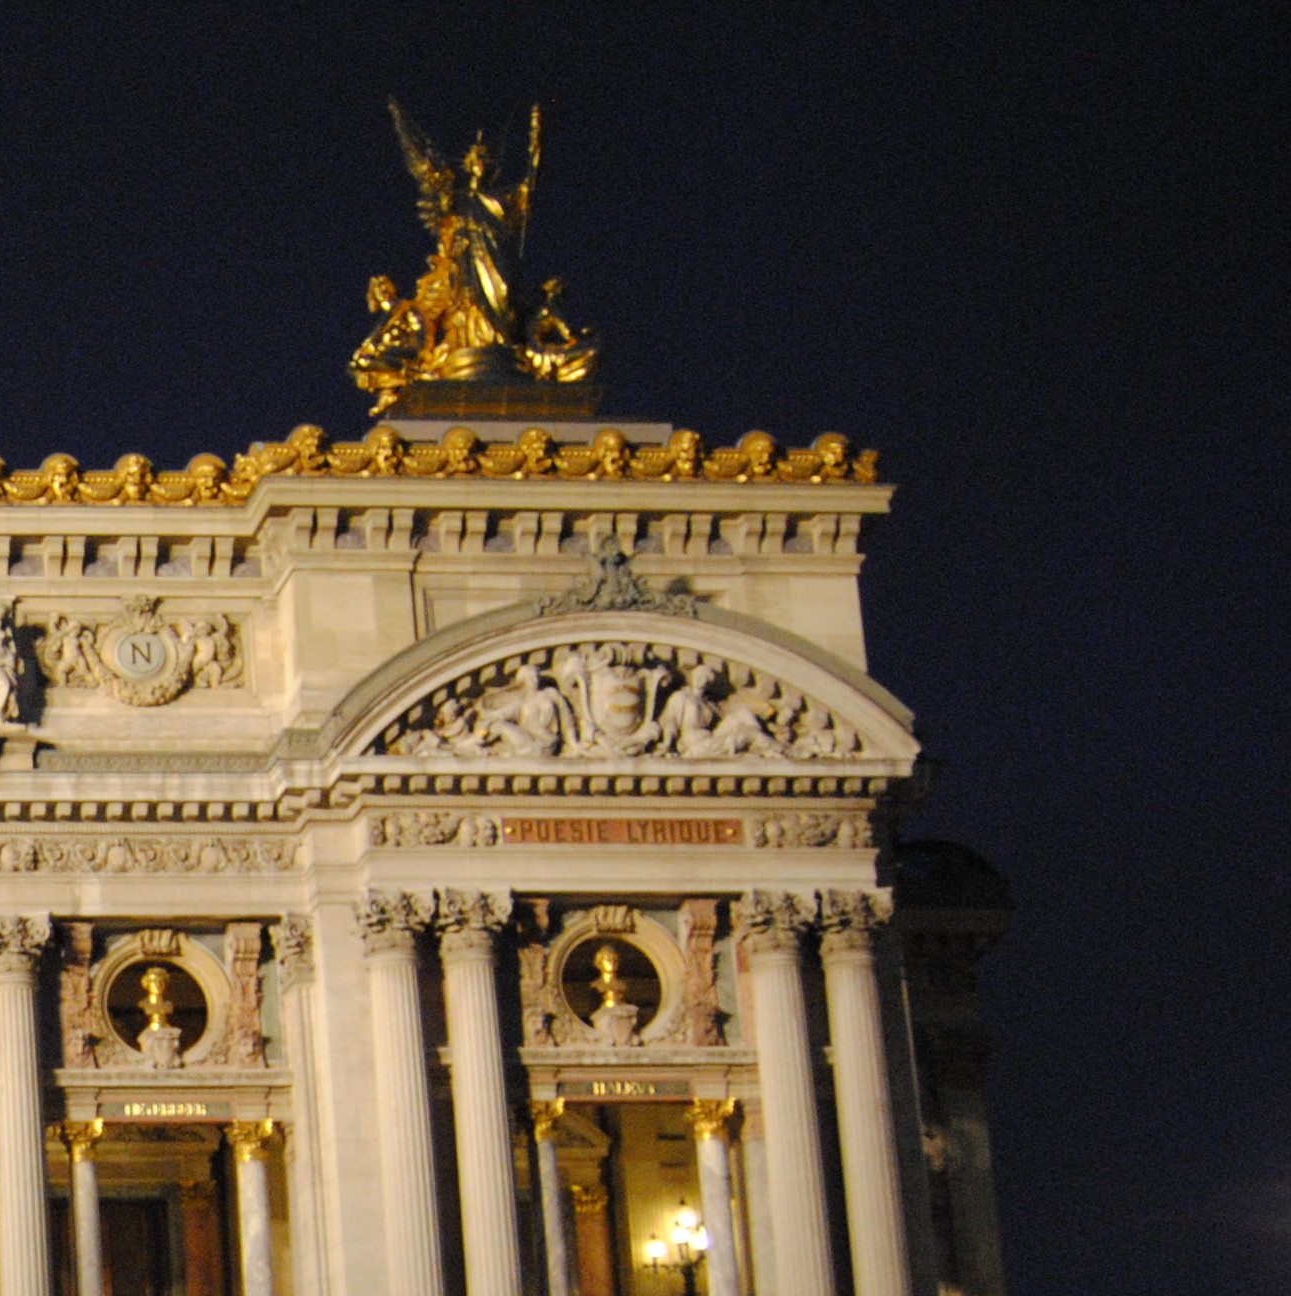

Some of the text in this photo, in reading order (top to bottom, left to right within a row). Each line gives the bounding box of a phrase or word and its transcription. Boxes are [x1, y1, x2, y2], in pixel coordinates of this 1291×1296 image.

[130, 642, 152, 665] N
[520, 818, 730, 845] POESIE LYRIQUE
